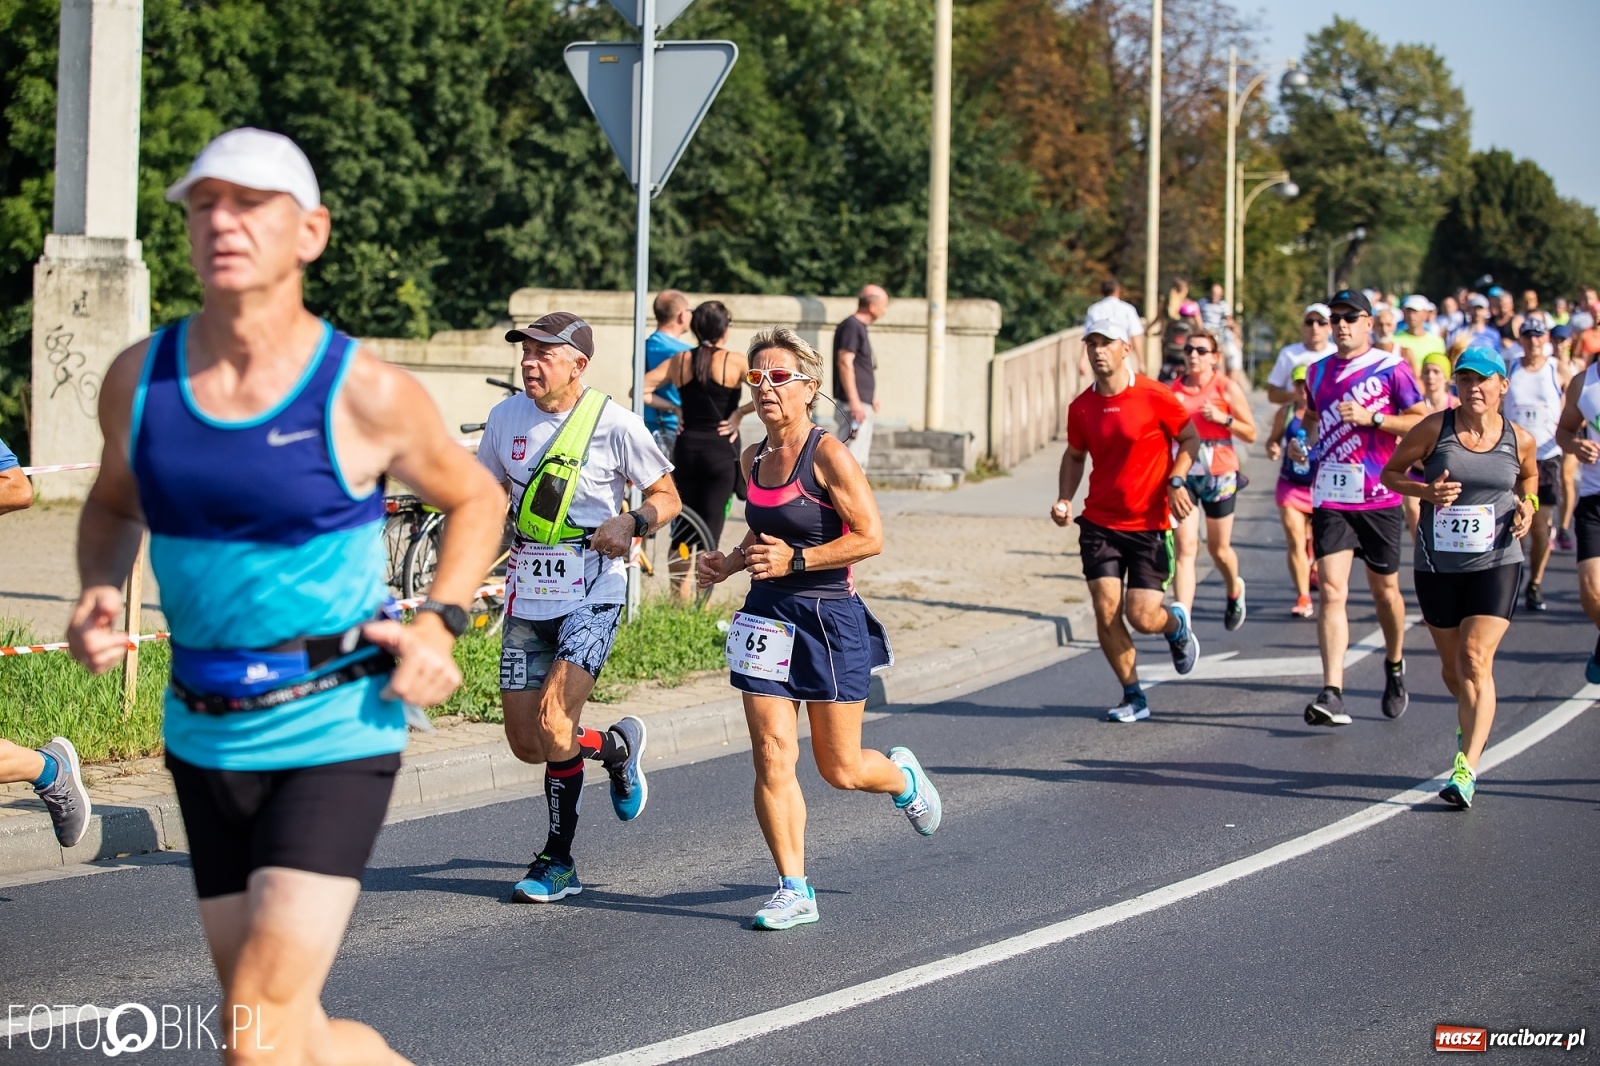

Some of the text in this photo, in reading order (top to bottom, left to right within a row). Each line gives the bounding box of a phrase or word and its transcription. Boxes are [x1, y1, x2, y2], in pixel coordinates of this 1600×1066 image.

[1333, 474, 1346, 486] 13
[1451, 518, 1480, 534] 273
[532, 558, 566, 578] 214
[746, 632, 768, 652] 65
[549, 777, 566, 835] Kalenji
